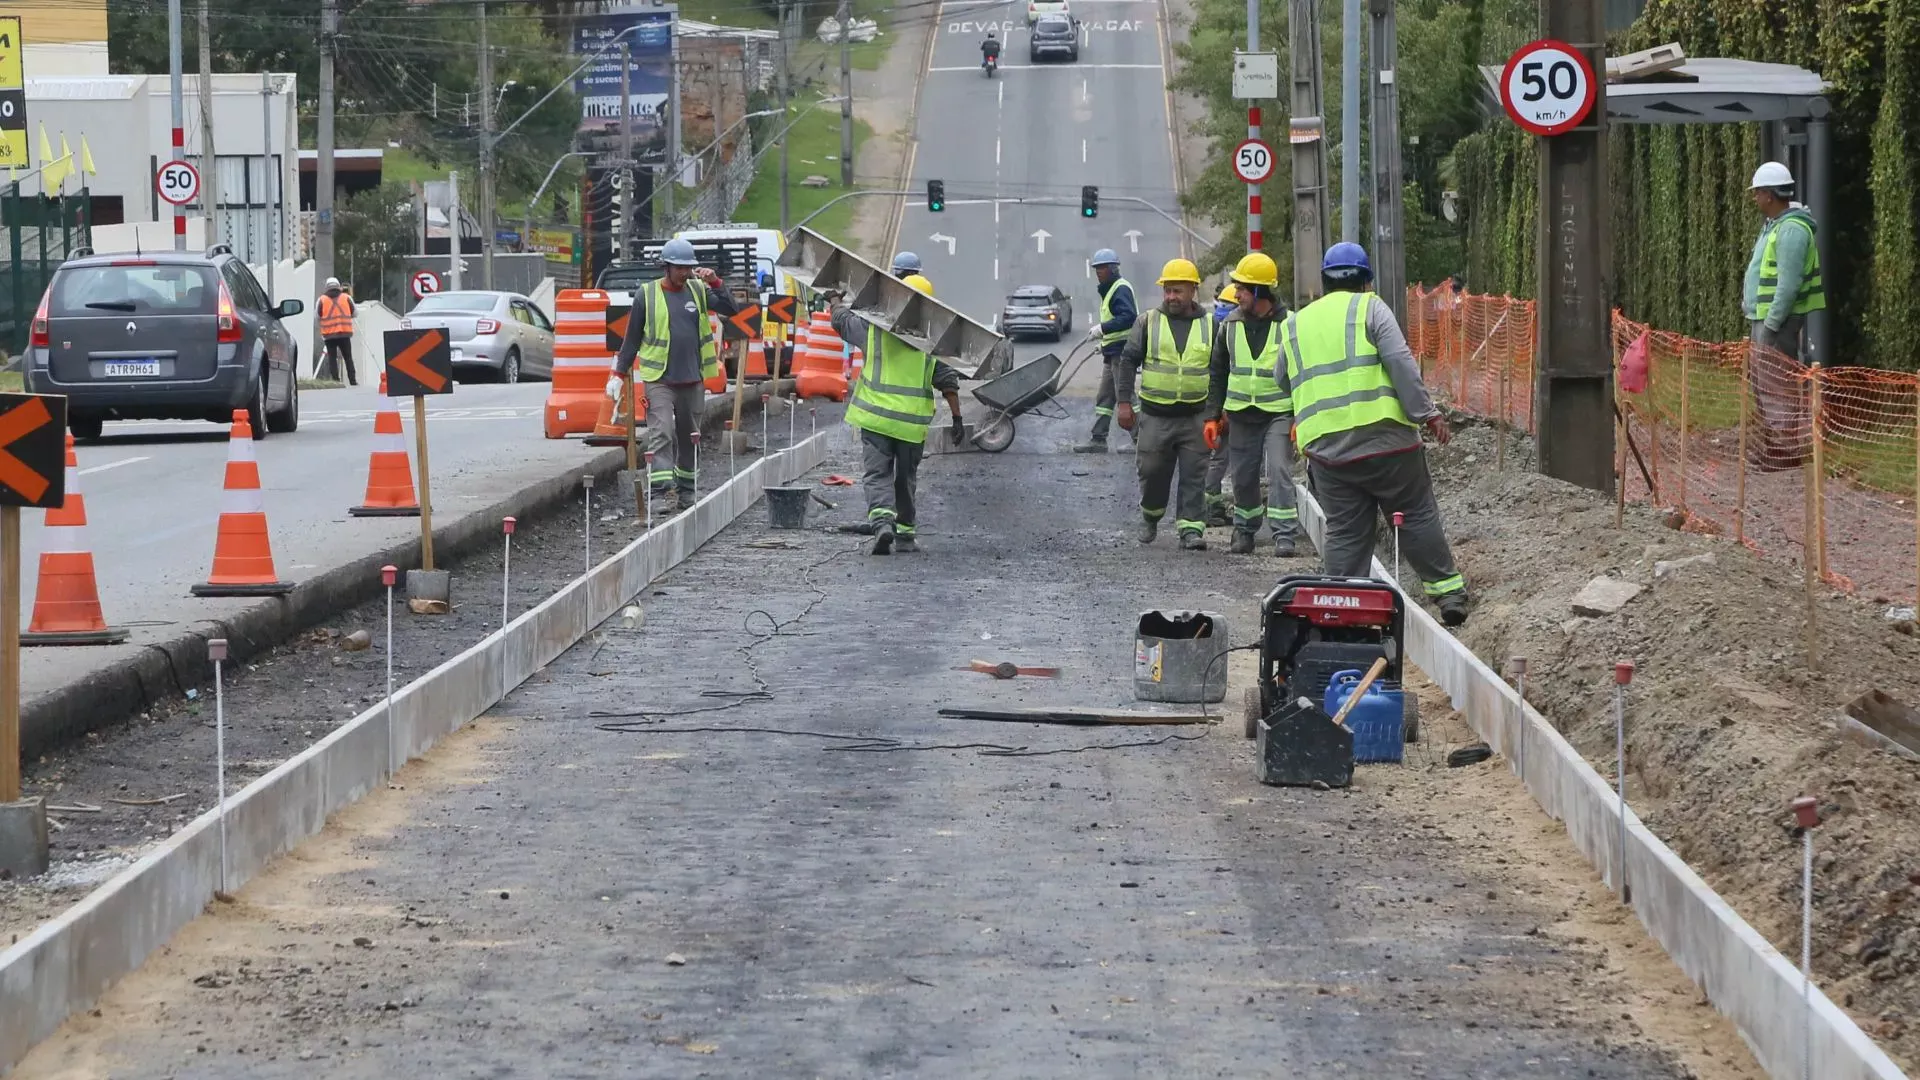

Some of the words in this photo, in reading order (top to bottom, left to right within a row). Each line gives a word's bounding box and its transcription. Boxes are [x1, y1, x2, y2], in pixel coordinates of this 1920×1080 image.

[1522, 61, 1577, 102] 50
[1535, 110, 1566, 120] km/h
[1240, 149, 1267, 167] 50
[165, 170, 192, 189] 50
[109, 364, 155, 375] ATR9H61
[1313, 594, 1361, 607] LOCPAR
